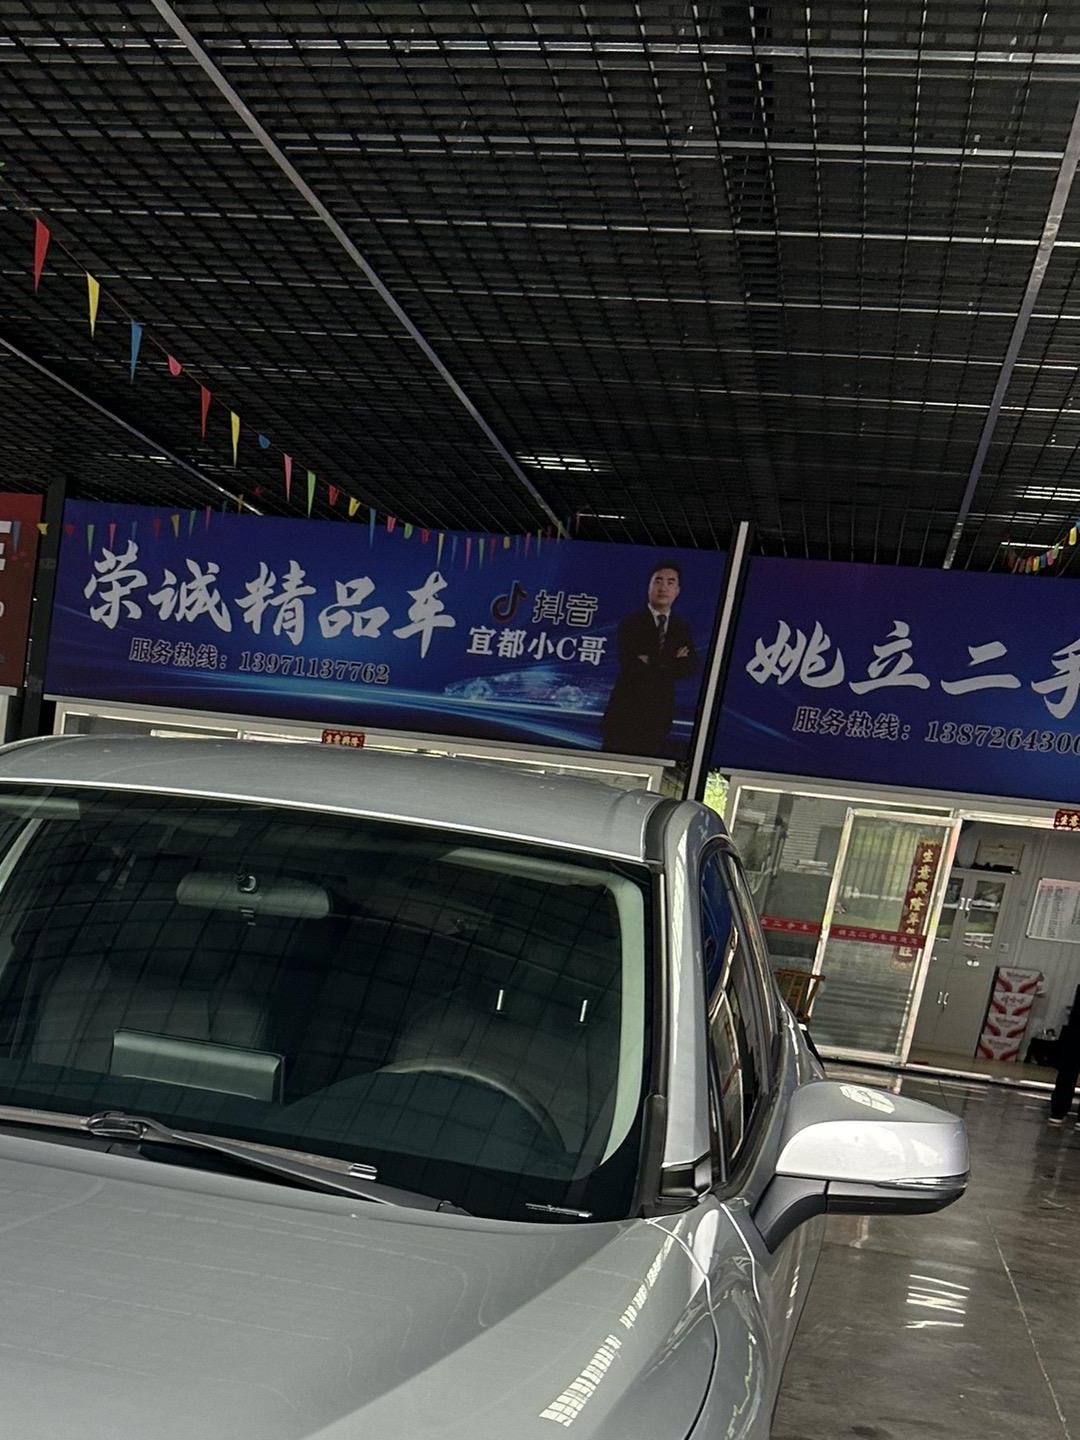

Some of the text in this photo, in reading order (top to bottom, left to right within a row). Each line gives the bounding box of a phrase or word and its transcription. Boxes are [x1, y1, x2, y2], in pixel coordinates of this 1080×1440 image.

[83, 539, 457, 658] 荣诚精品车
[531, 589, 598, 628] 抖音
[466, 625, 608, 666] 宜都小C哥
